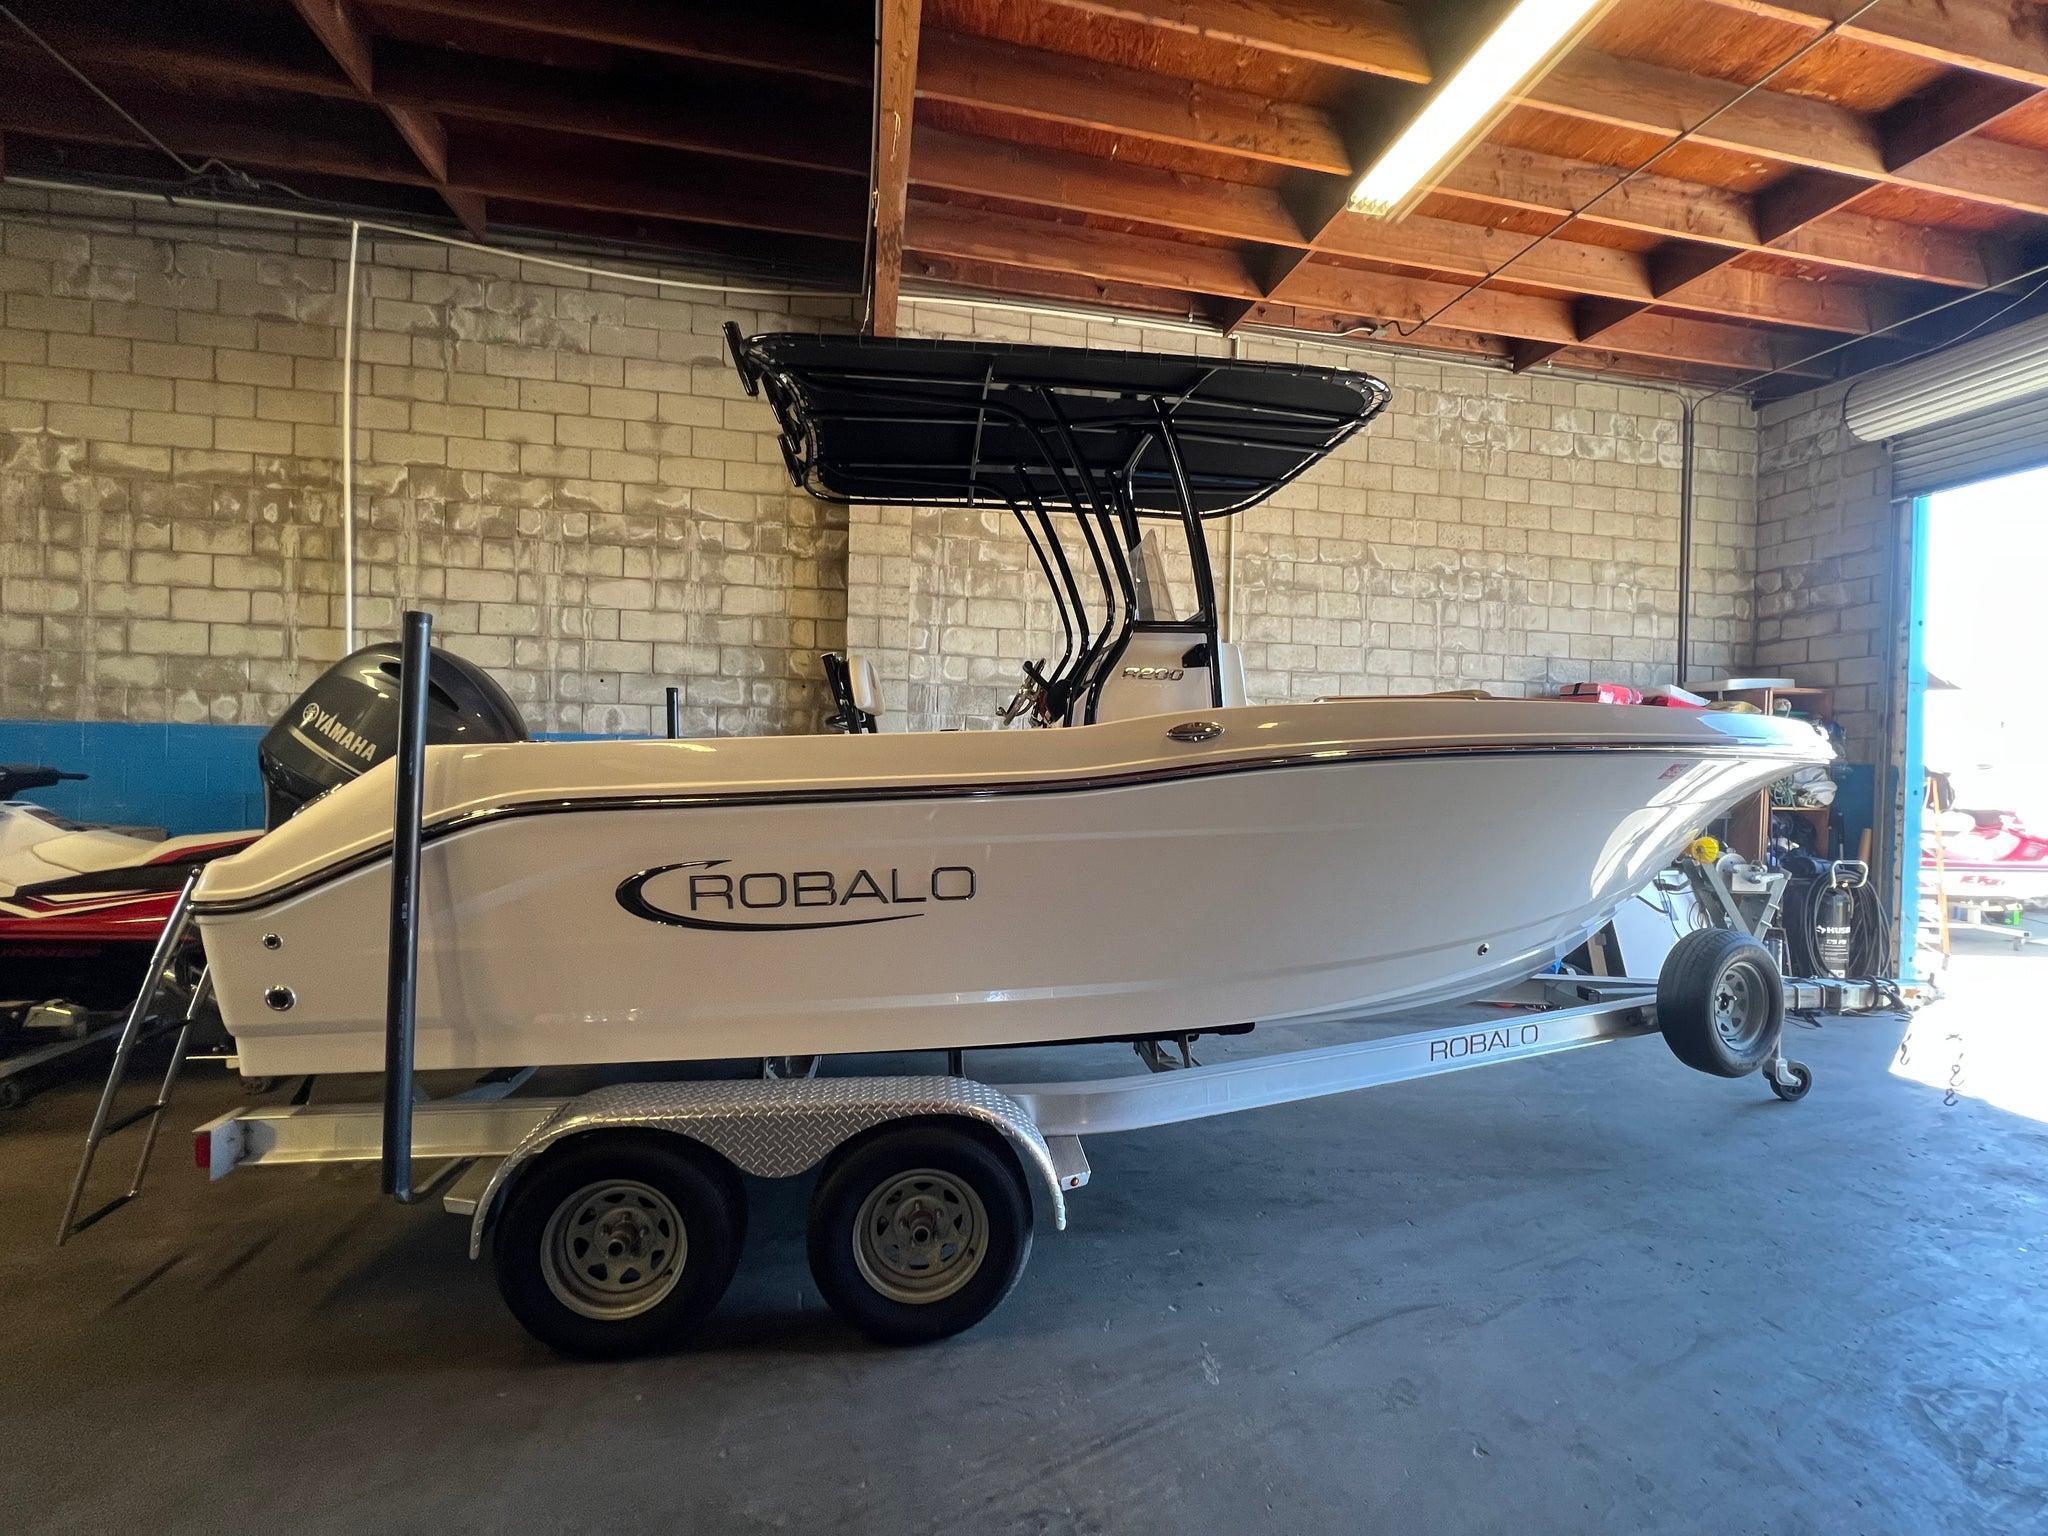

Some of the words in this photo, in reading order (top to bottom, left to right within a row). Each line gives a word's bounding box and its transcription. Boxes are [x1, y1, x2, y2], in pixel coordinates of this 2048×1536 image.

[1121, 667, 1184, 681] R200
[314, 710, 377, 762] YAMAHA
[689, 866, 977, 910] ROBALO
[1430, 1024, 1538, 1061] ROBALO
